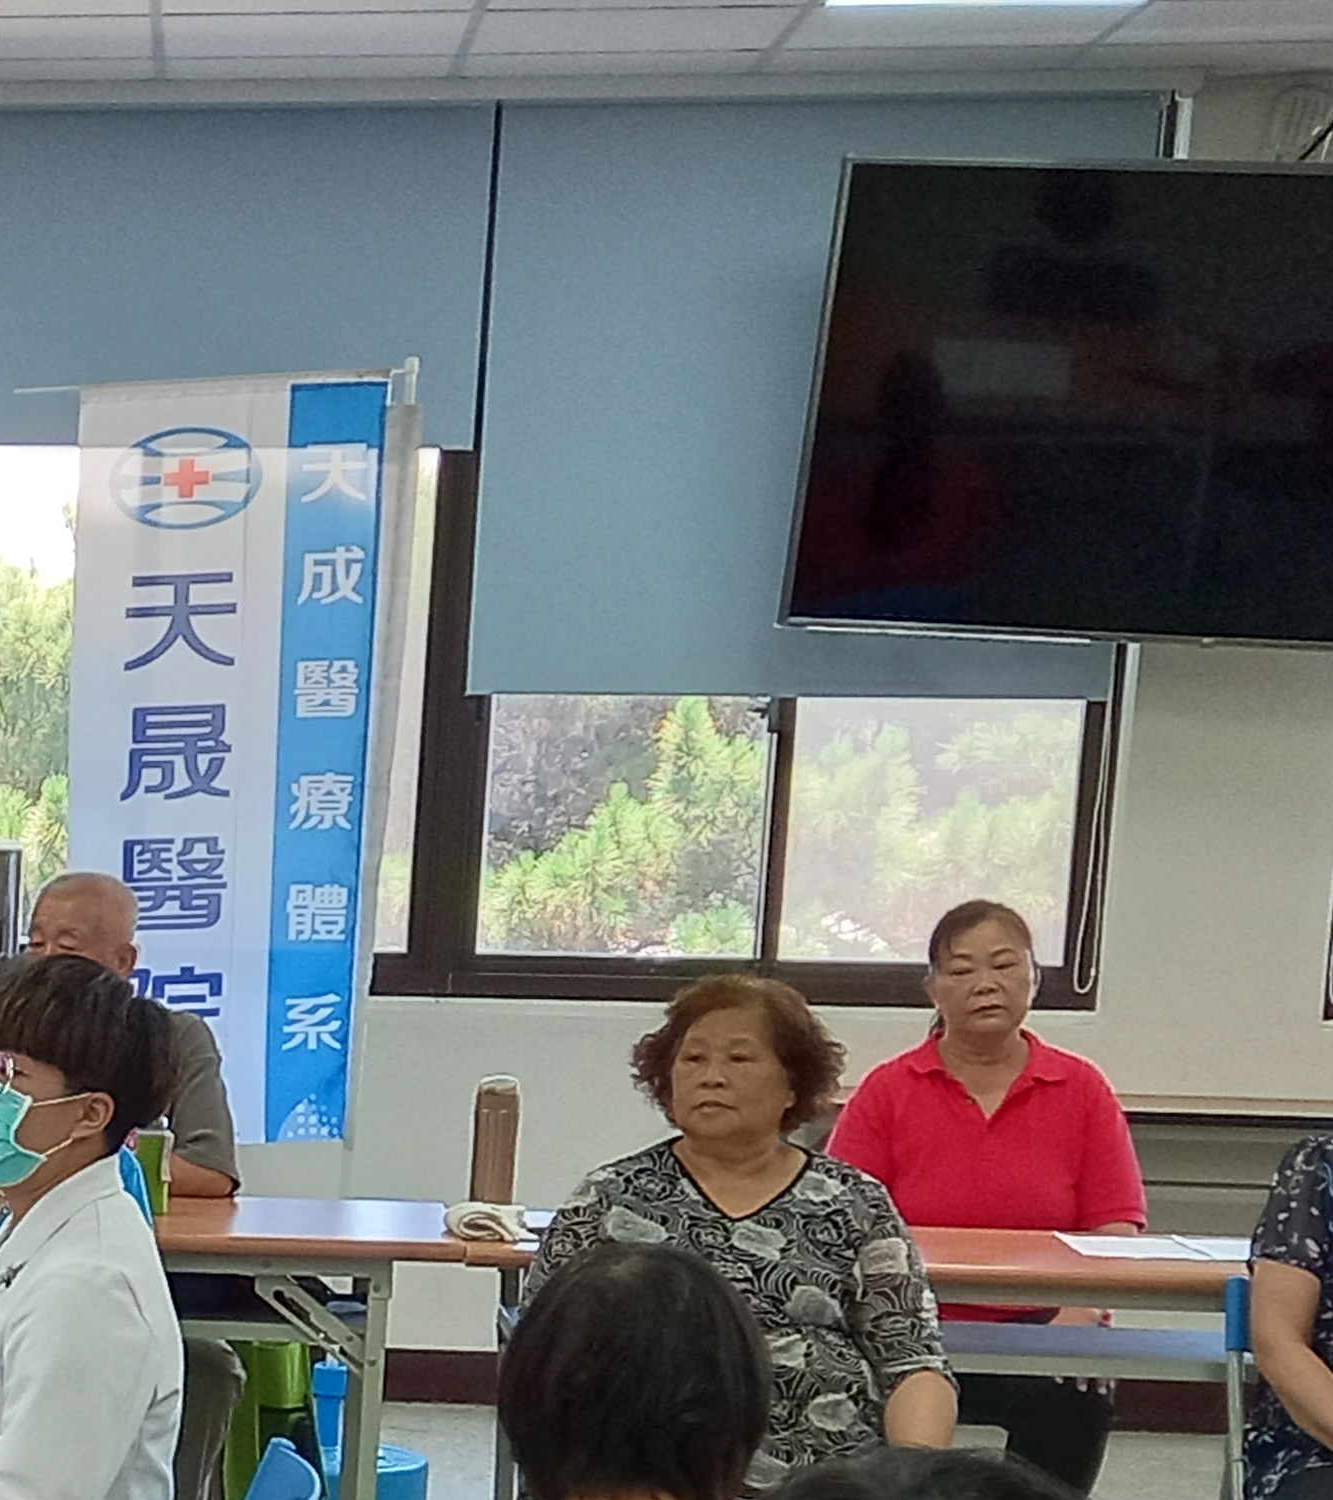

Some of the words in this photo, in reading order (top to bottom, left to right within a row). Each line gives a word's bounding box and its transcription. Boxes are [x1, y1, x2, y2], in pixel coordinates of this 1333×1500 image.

[281, 442, 369, 1053] 天成醫療體系
